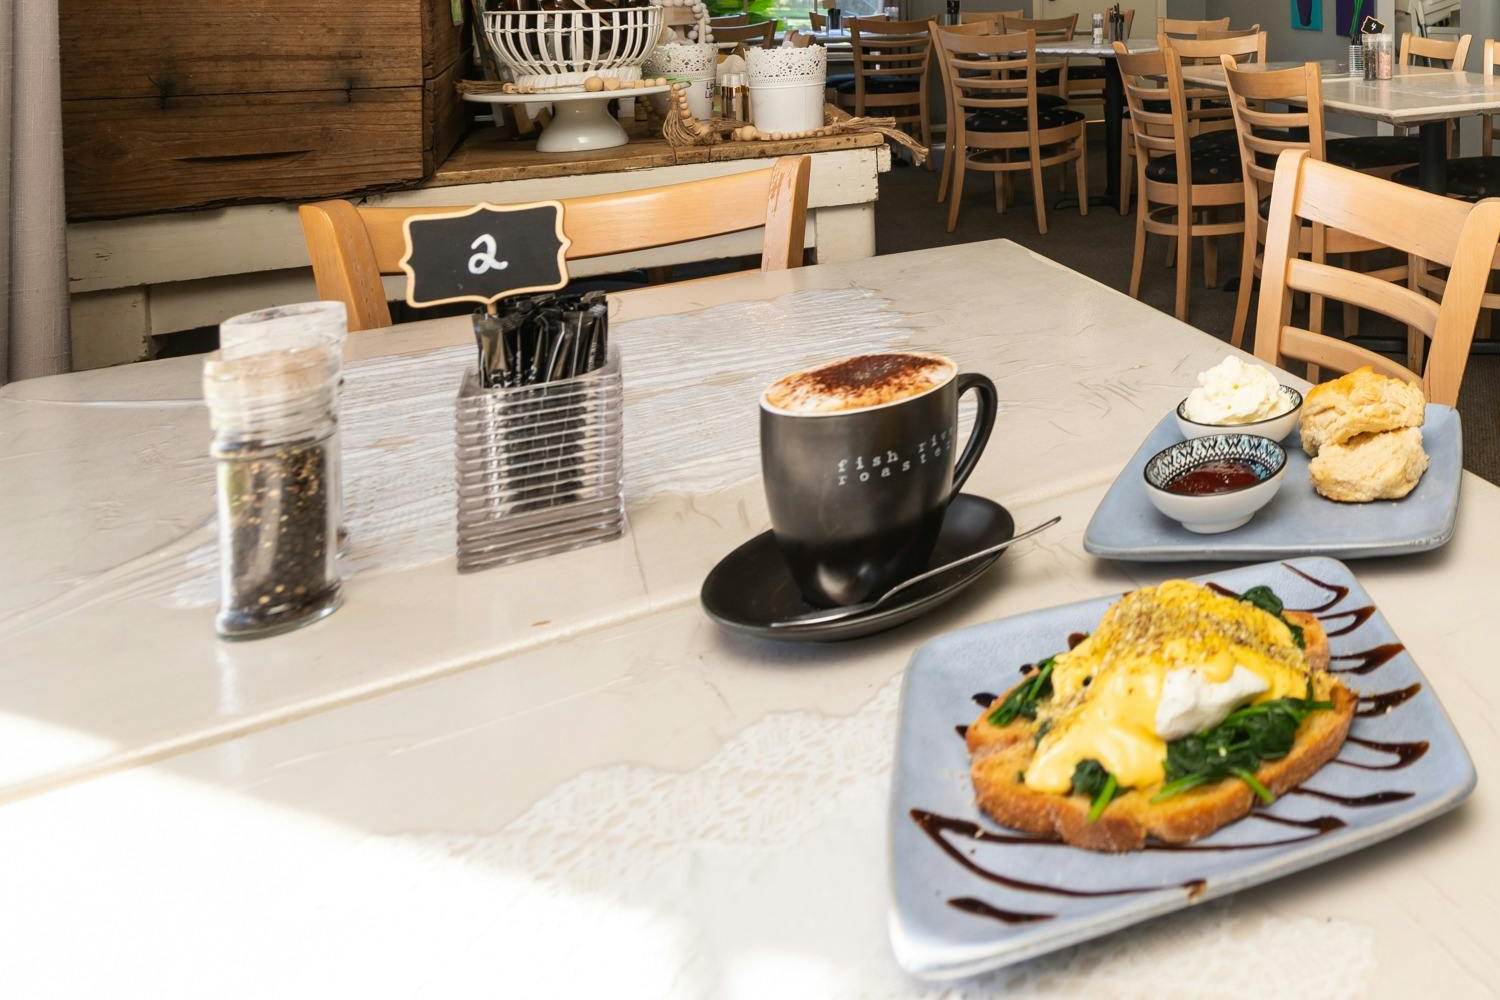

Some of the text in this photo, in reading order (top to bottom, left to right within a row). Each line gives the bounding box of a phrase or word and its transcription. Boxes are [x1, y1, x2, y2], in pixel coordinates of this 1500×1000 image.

[1371, 22, 1377, 31] 4
[467, 233, 508, 275] 2
[838, 450, 899, 473] fish
